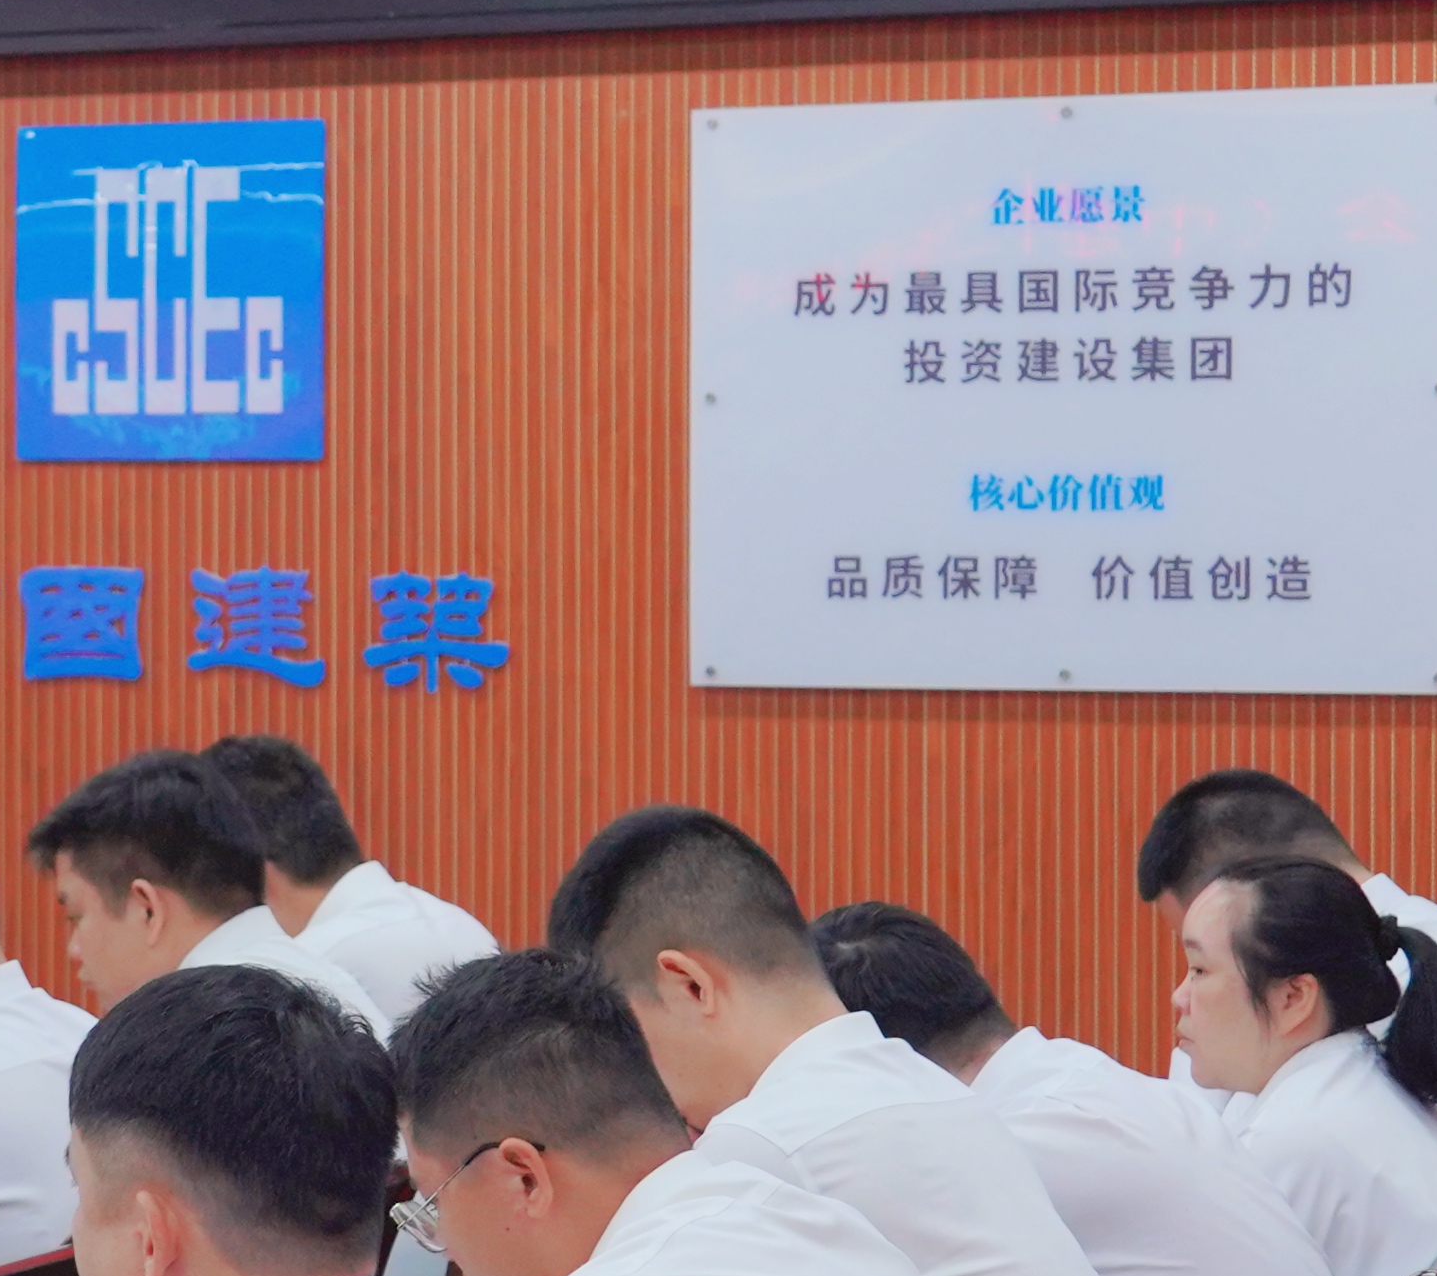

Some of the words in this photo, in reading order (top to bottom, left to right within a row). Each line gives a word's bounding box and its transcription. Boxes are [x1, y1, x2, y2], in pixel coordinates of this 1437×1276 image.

[991, 185, 1147, 227] 企业愿景
[793, 263, 1354, 319] 成为最具国际竞争力的
[904, 337, 1234, 385] 投资建设集团
[968, 472, 1166, 514] 核心价值观
[826, 555, 1039, 602] 品质保障
[1091, 555, 1313, 602] 价值创造
